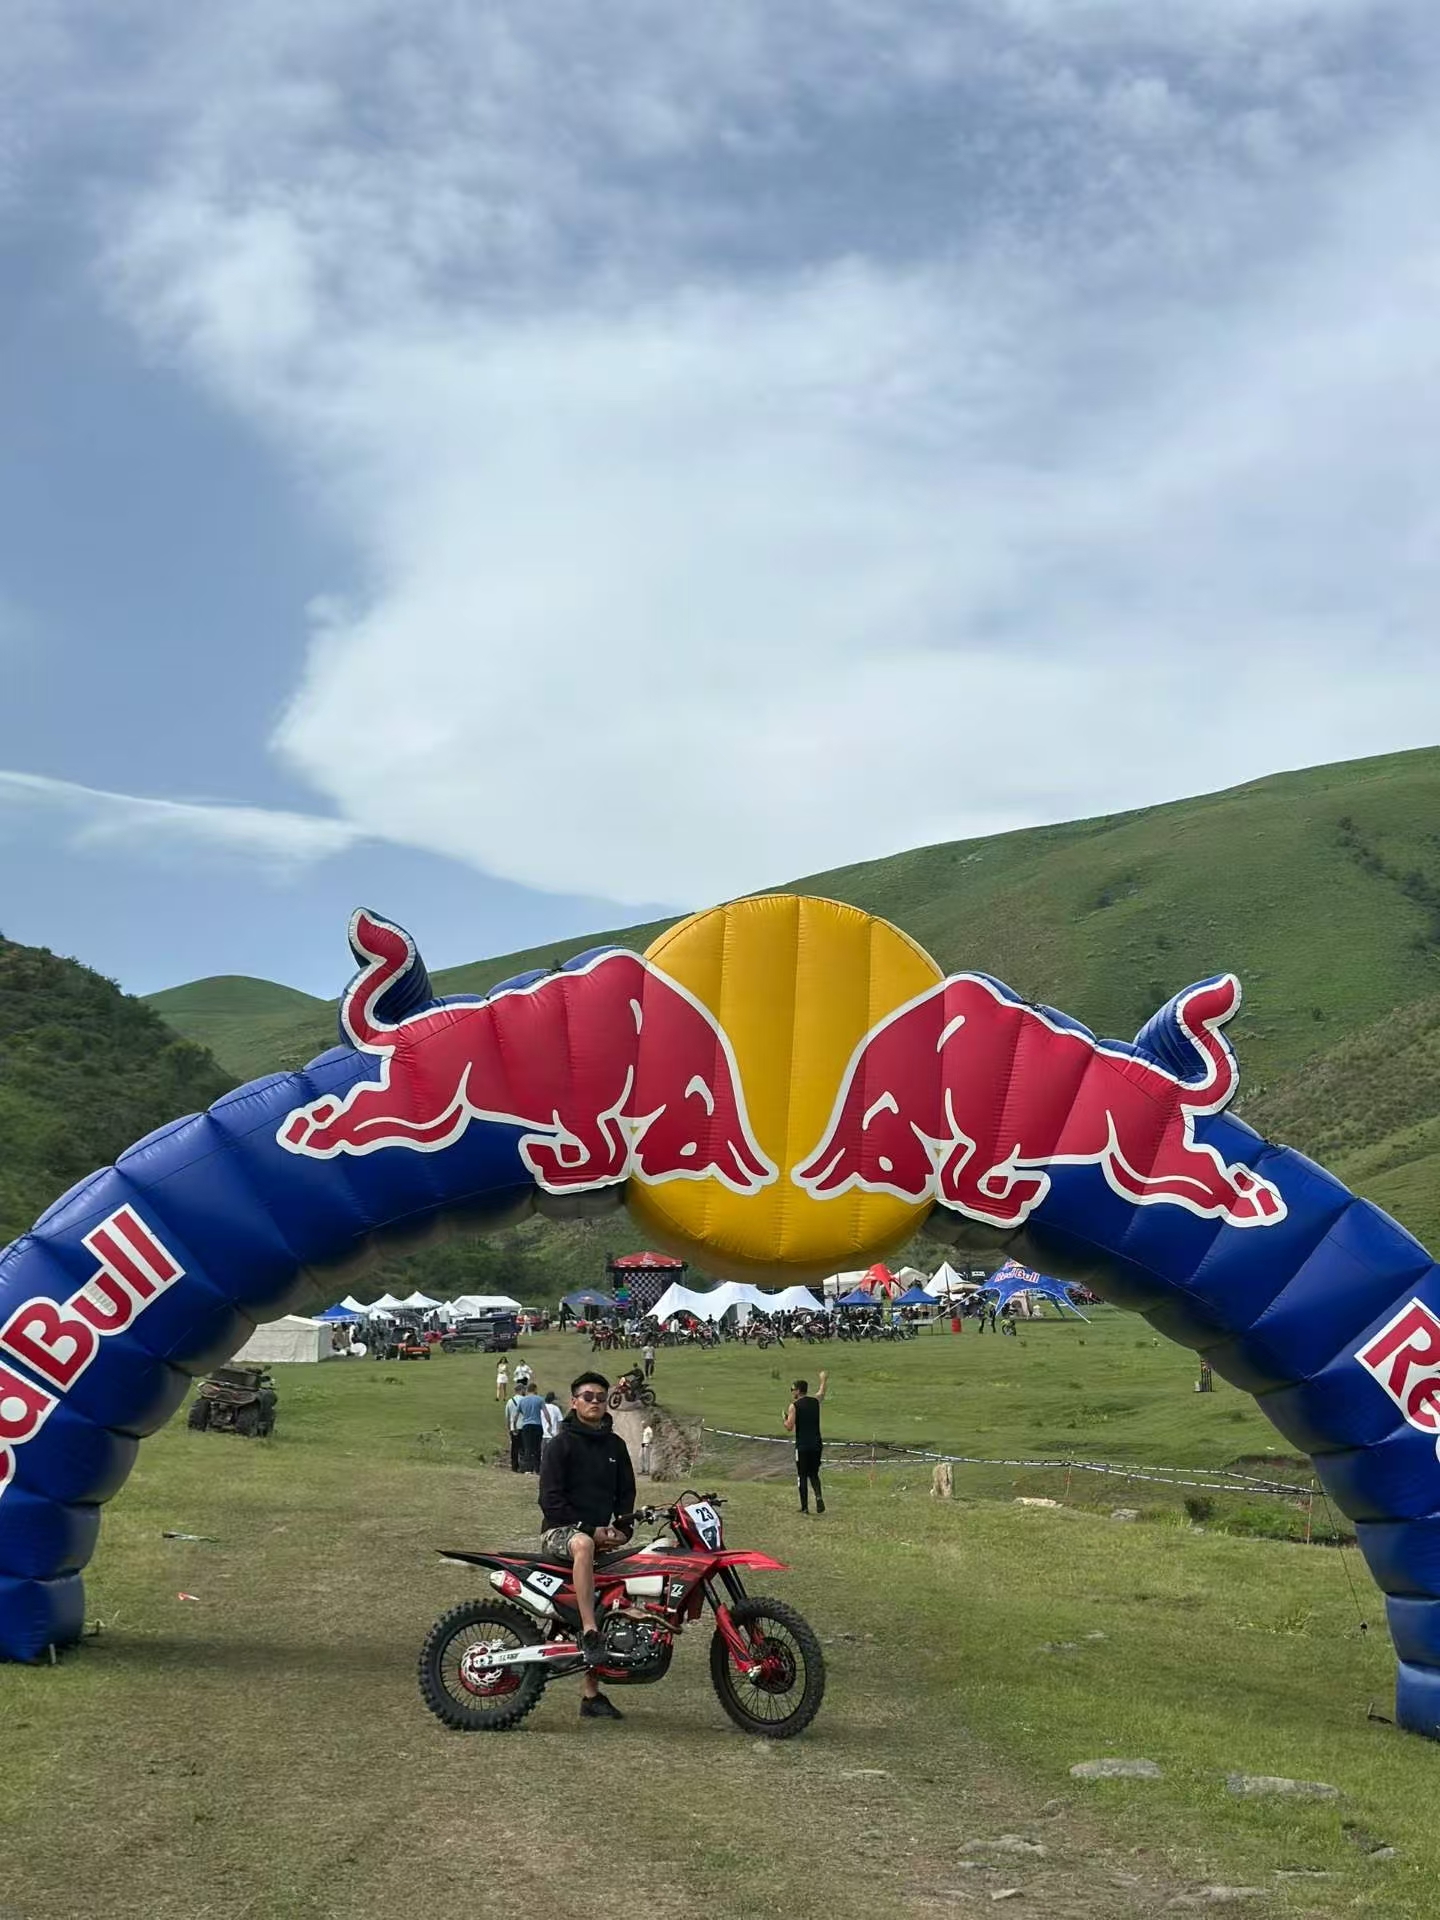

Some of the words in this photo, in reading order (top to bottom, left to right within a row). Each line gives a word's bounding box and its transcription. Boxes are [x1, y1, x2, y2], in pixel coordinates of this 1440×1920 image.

[994, 1267, 1017, 1282] Red
[1015, 1267, 1040, 1283] Bull
[1, 1206, 180, 1388] Bull
[1358, 1300, 1440, 1431] Re
[695, 1506, 715, 1522] 23
[536, 1573, 554, 1588] 23
